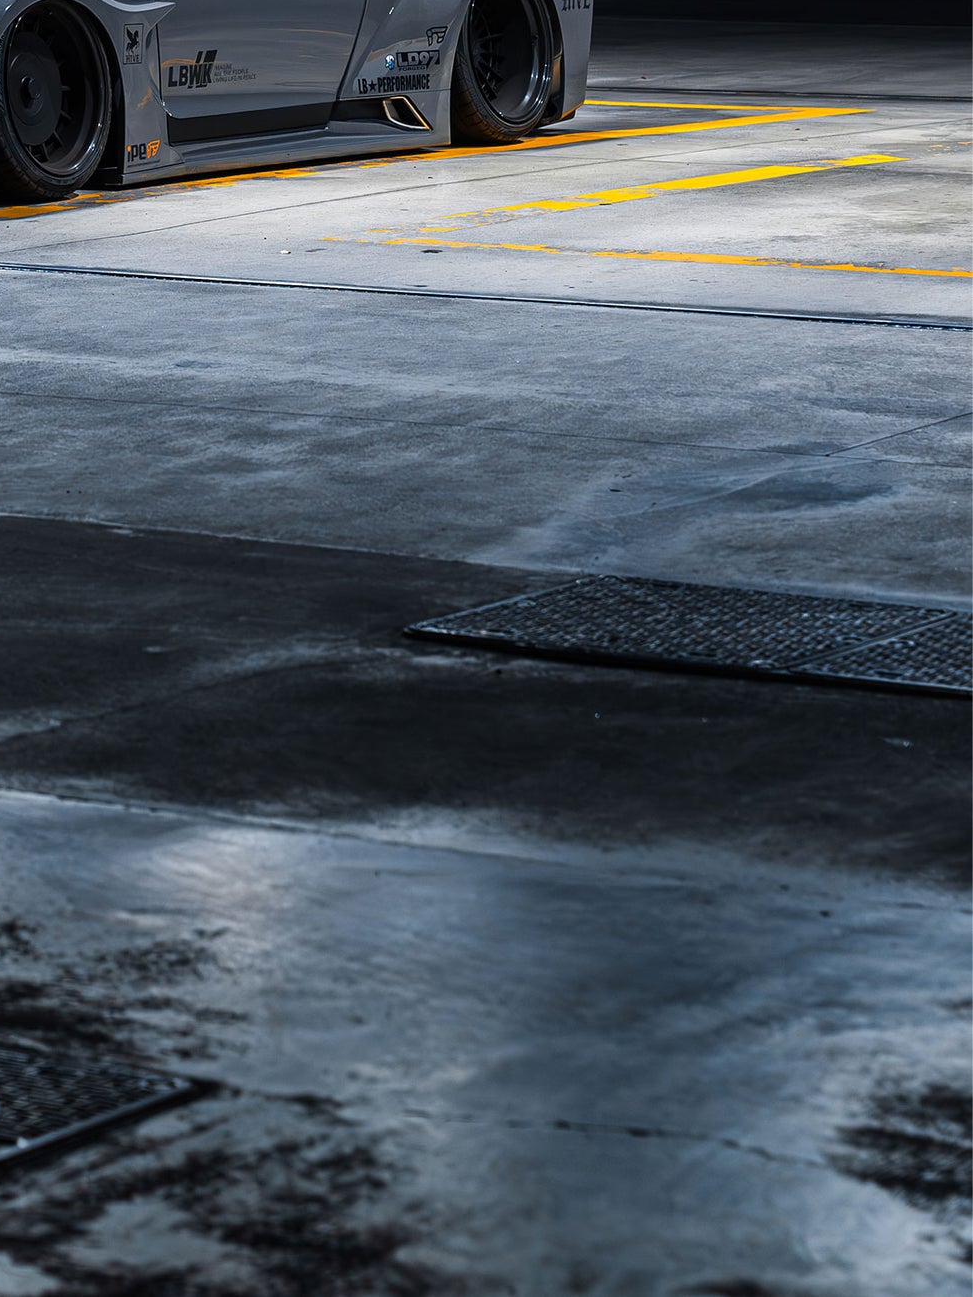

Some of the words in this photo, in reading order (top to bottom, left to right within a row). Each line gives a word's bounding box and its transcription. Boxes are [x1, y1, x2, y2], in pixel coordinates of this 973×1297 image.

[168, 63, 214, 89] LBWK
[357, 78, 368, 95] LB
[377, 74, 431, 93] PERFORMANCE
